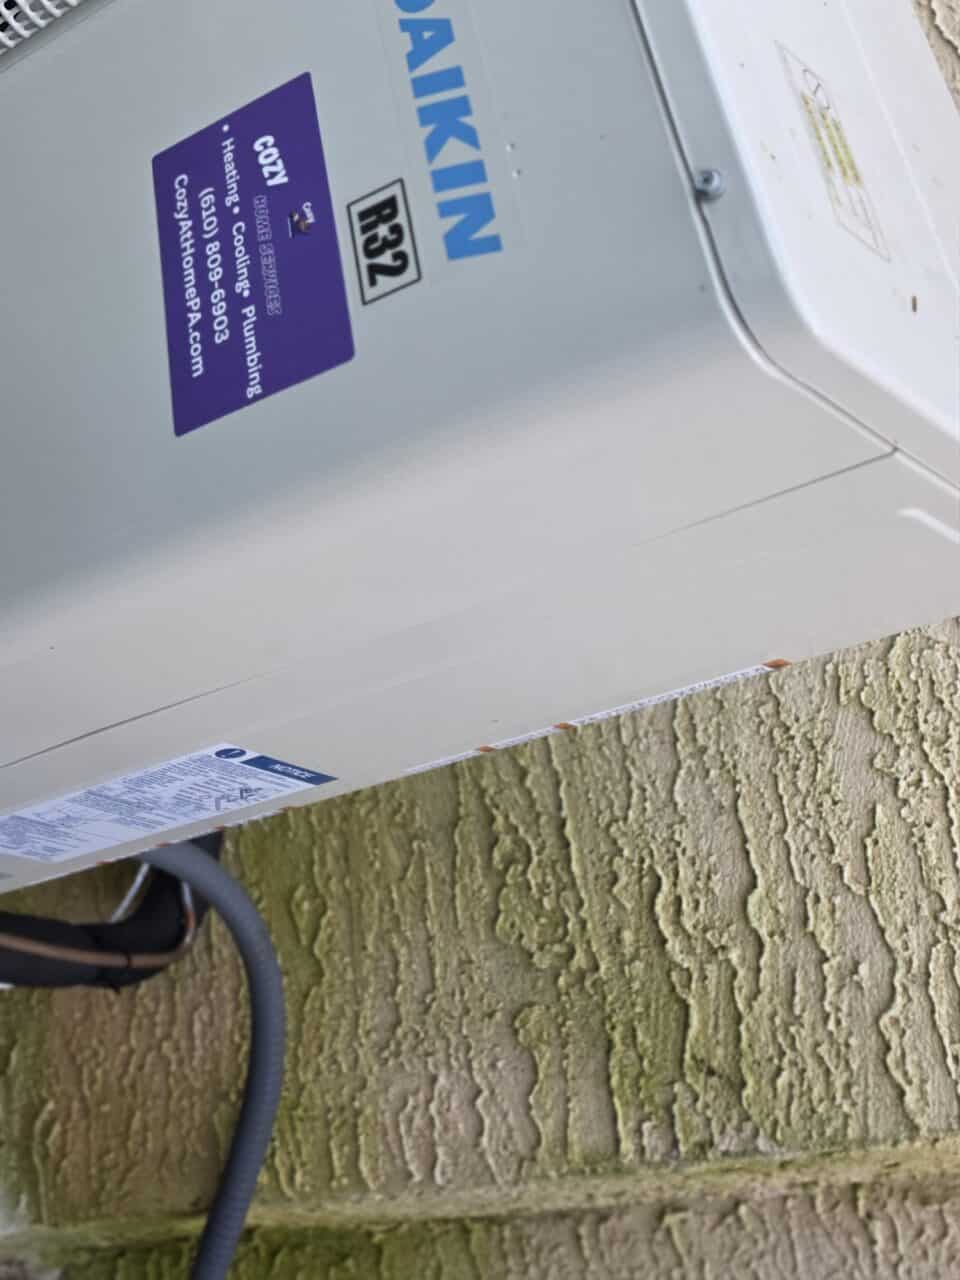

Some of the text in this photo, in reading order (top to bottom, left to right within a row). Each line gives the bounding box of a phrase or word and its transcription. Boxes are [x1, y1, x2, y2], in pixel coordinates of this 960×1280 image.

[253, 135, 289, 187] COZY
[173, 173, 204, 379] CozyAtHomePA.com
[198, 187, 230, 345] (610) 809-6903
[221, 137, 263, 399] Heating Cooling Plumbing
[253, 194, 283, 316] HOME SERVICES
[357, 194, 409, 288] R32
